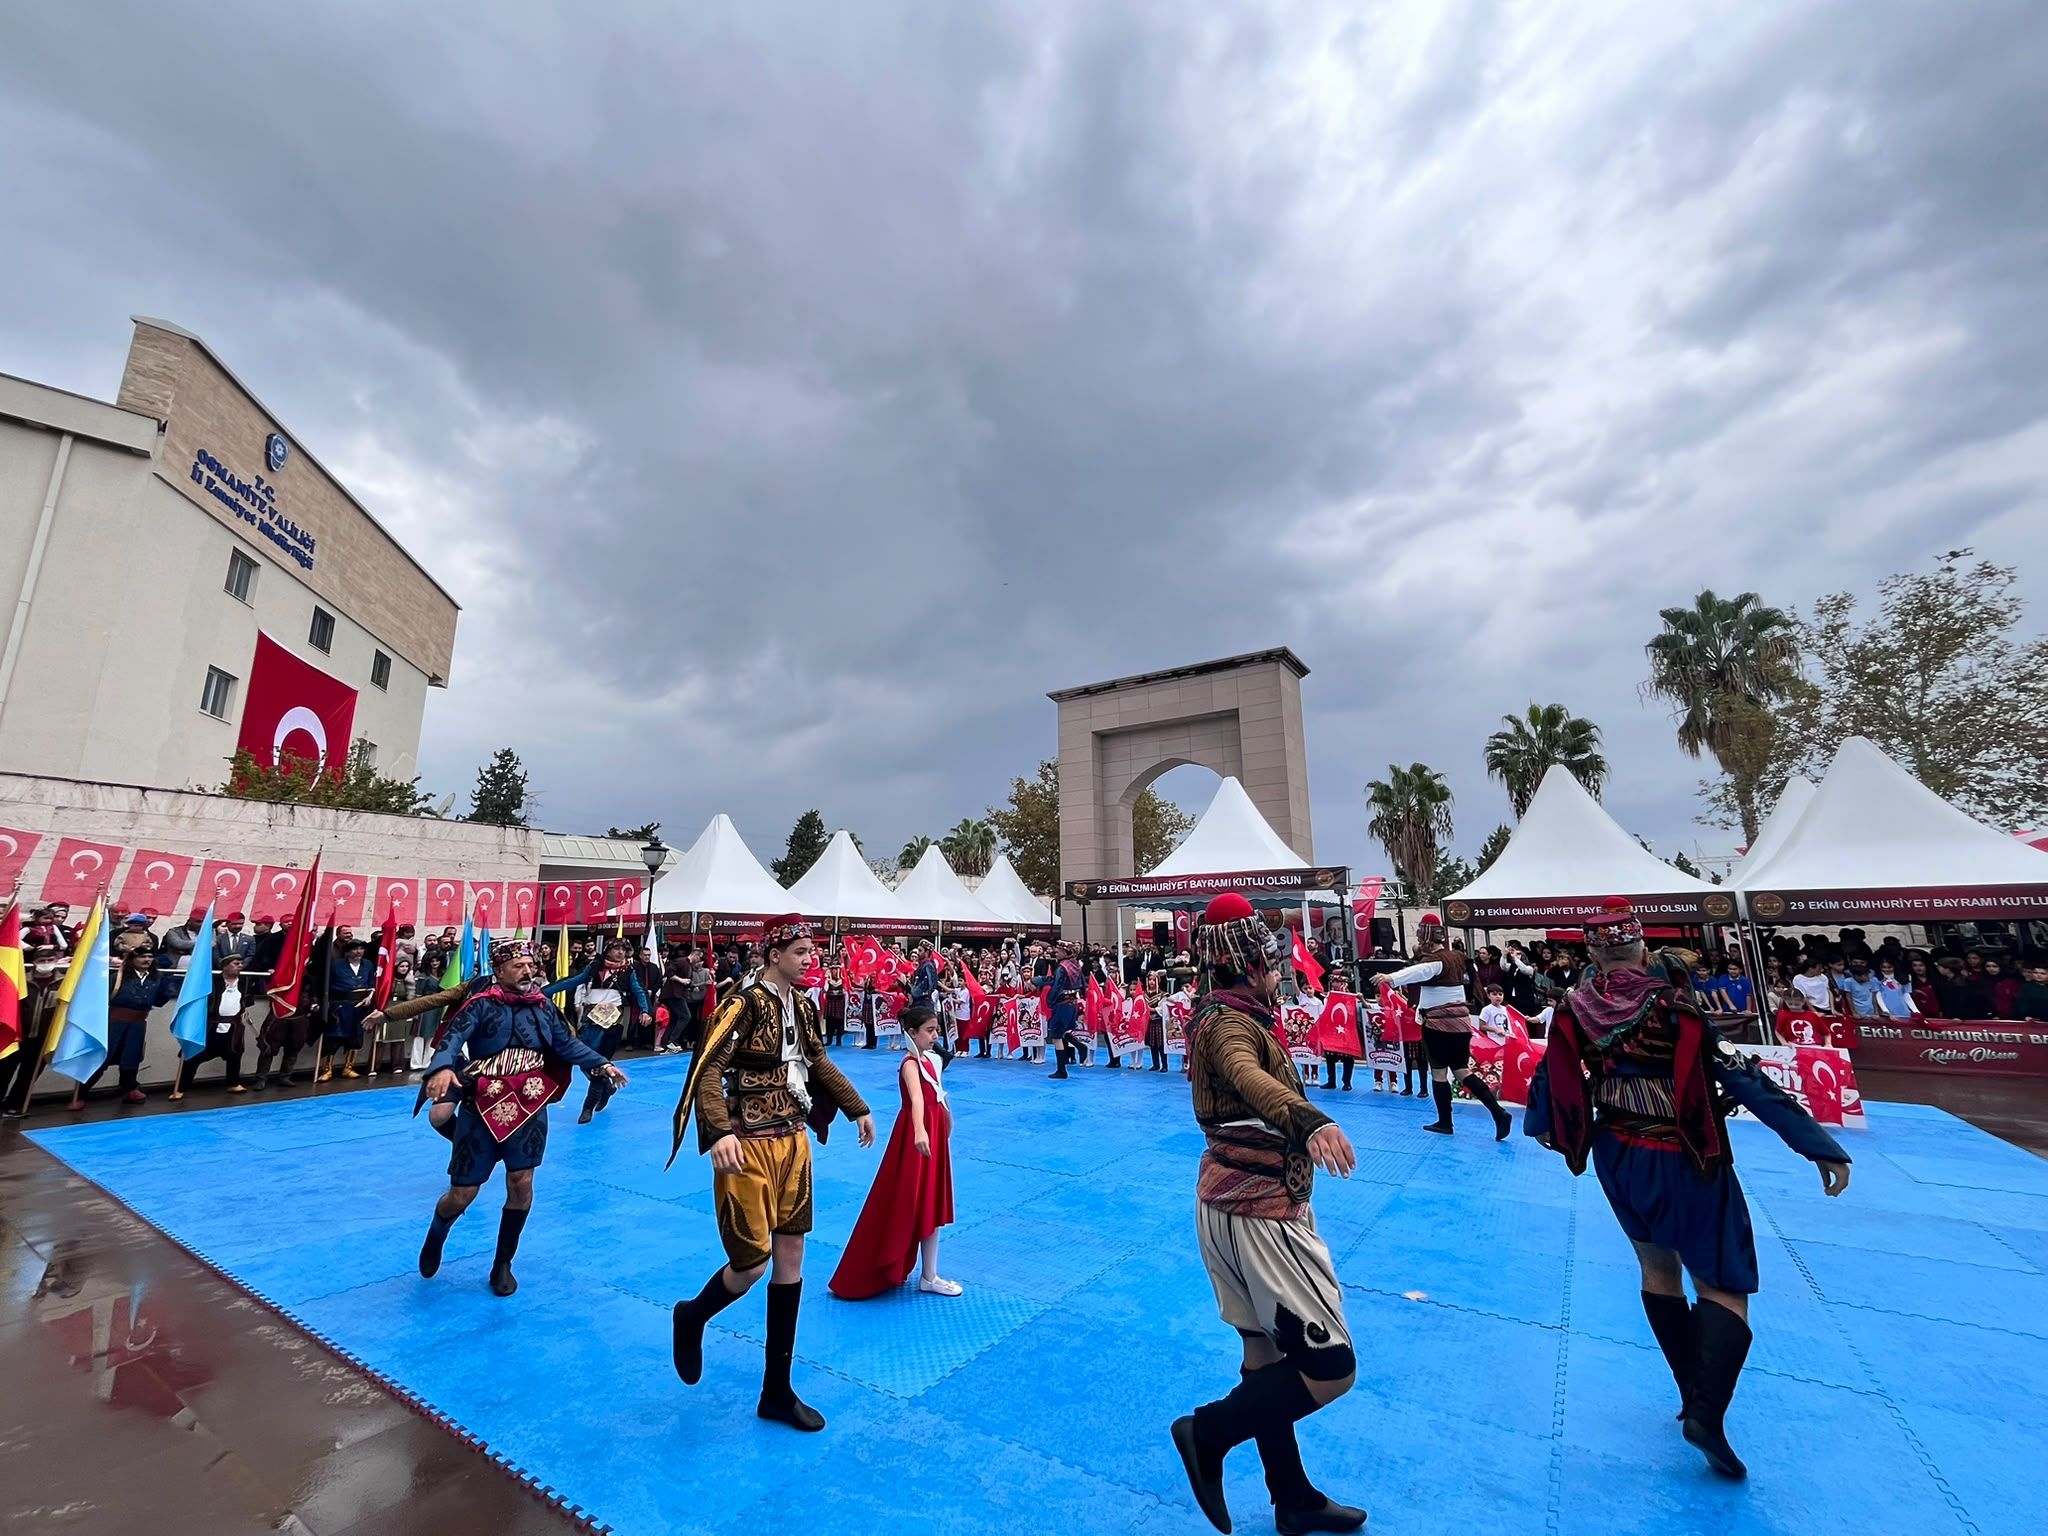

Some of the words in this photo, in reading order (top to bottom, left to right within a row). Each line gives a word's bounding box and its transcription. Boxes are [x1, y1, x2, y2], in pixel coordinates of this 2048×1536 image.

[205, 475, 257, 526] Emniyet
[1097, 885, 1107, 894] 29
[1109, 883, 1130, 894] EKİM
[1131, 880, 1188, 892] CUMHURİYET
[1189, 878, 1231, 889] BAYRAMI
[1232, 876, 1266, 887] KUTLU
[1268, 875, 1302, 886] OLSUN
[1474, 908, 1485, 917] 29
[1487, 907, 1510, 916] EKİM
[1511, 905, 1575, 916] CUMHURİYET
[1630, 904, 1658, 913] UTLU
[1659, 904, 1698, 913] OLSUN
[1790, 901, 1805, 910] 29
[1808, 899, 1839, 910] EKİM
[1842, 897, 1930, 909] CUMHURİYET
[1933, 898, 1998, 908] BAYRAMI
[1859, 1025, 1903, 1039] EKİM
[1911, 1029, 2023, 1044] CUMHURİYET
[1920, 1048, 1967, 1065] Kutlu
[1969, 1047, 2019, 1062] Olsun
